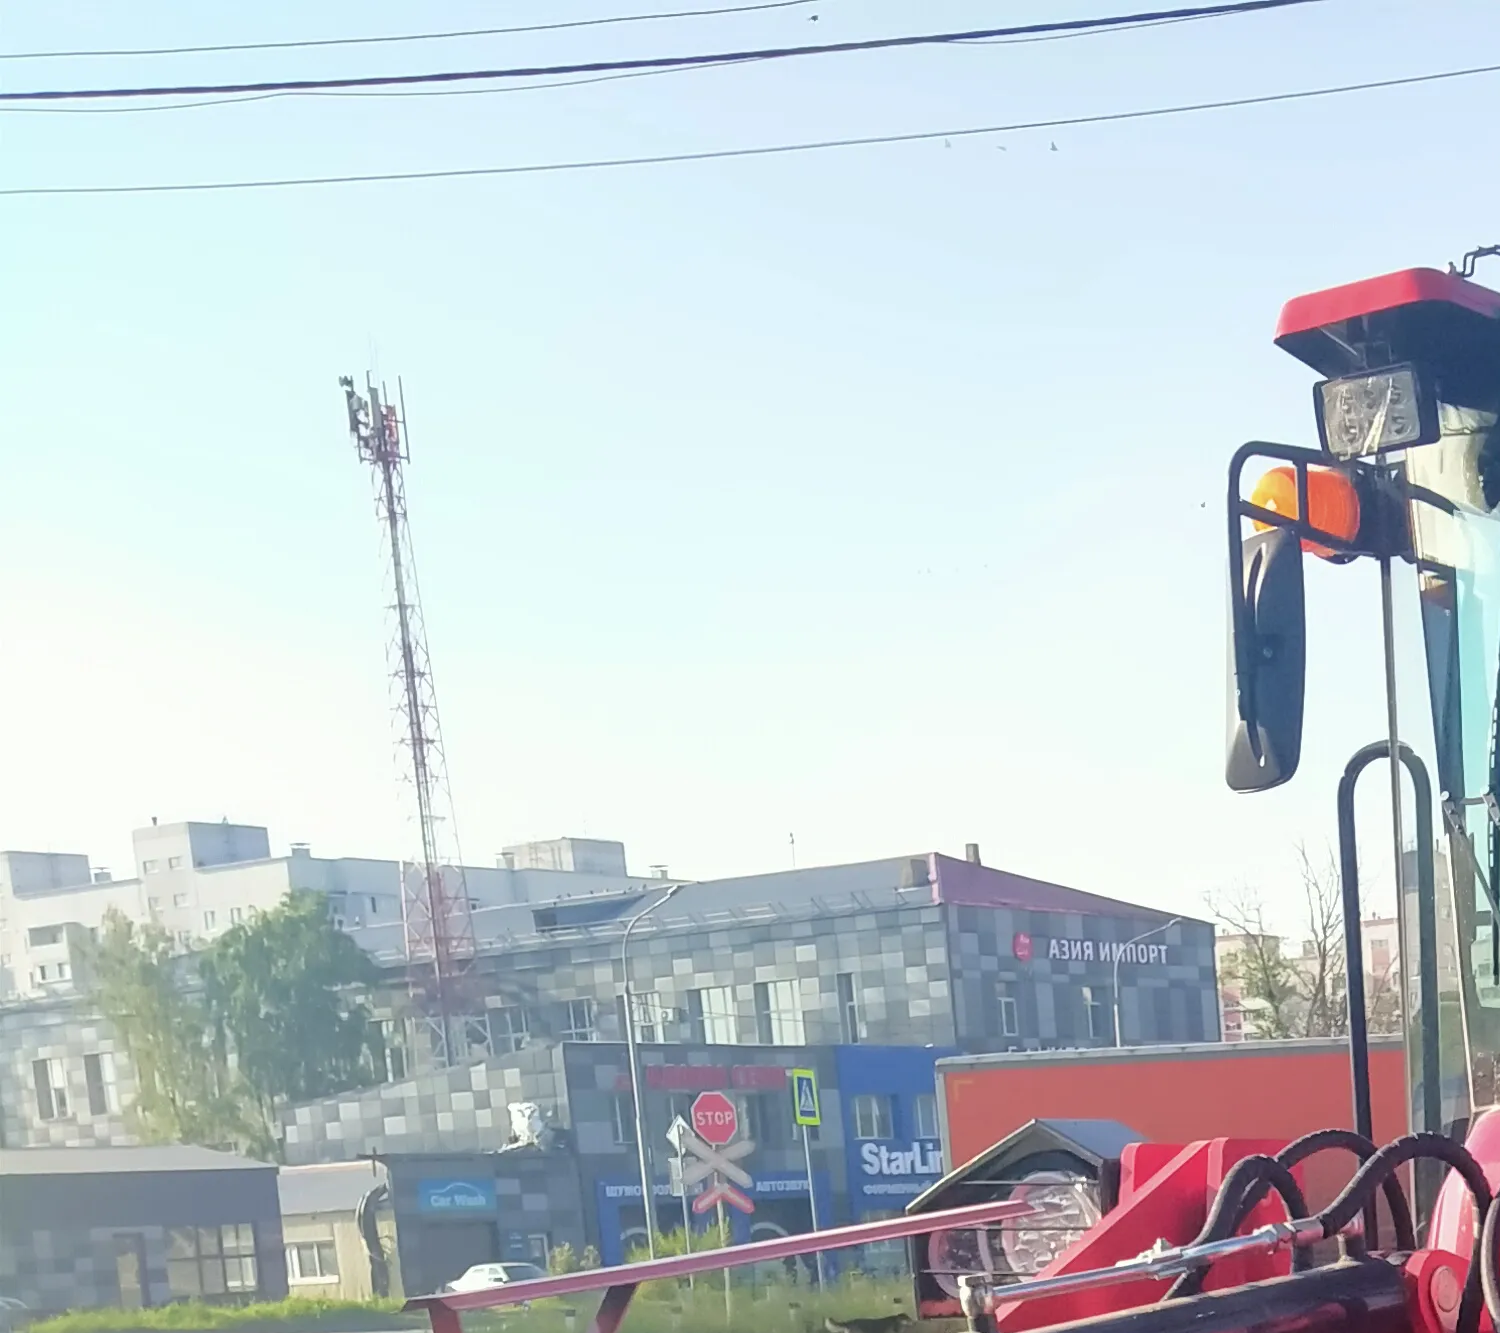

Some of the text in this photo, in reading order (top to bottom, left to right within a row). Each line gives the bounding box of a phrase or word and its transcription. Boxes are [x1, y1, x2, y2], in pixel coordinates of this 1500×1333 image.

[1050, 939, 1094, 961] АЗИЯ
[1099, 941, 1168, 964] ИМПОРТ
[696, 1111, 734, 1126] STOP
[430, 1195, 452, 1207] Car
